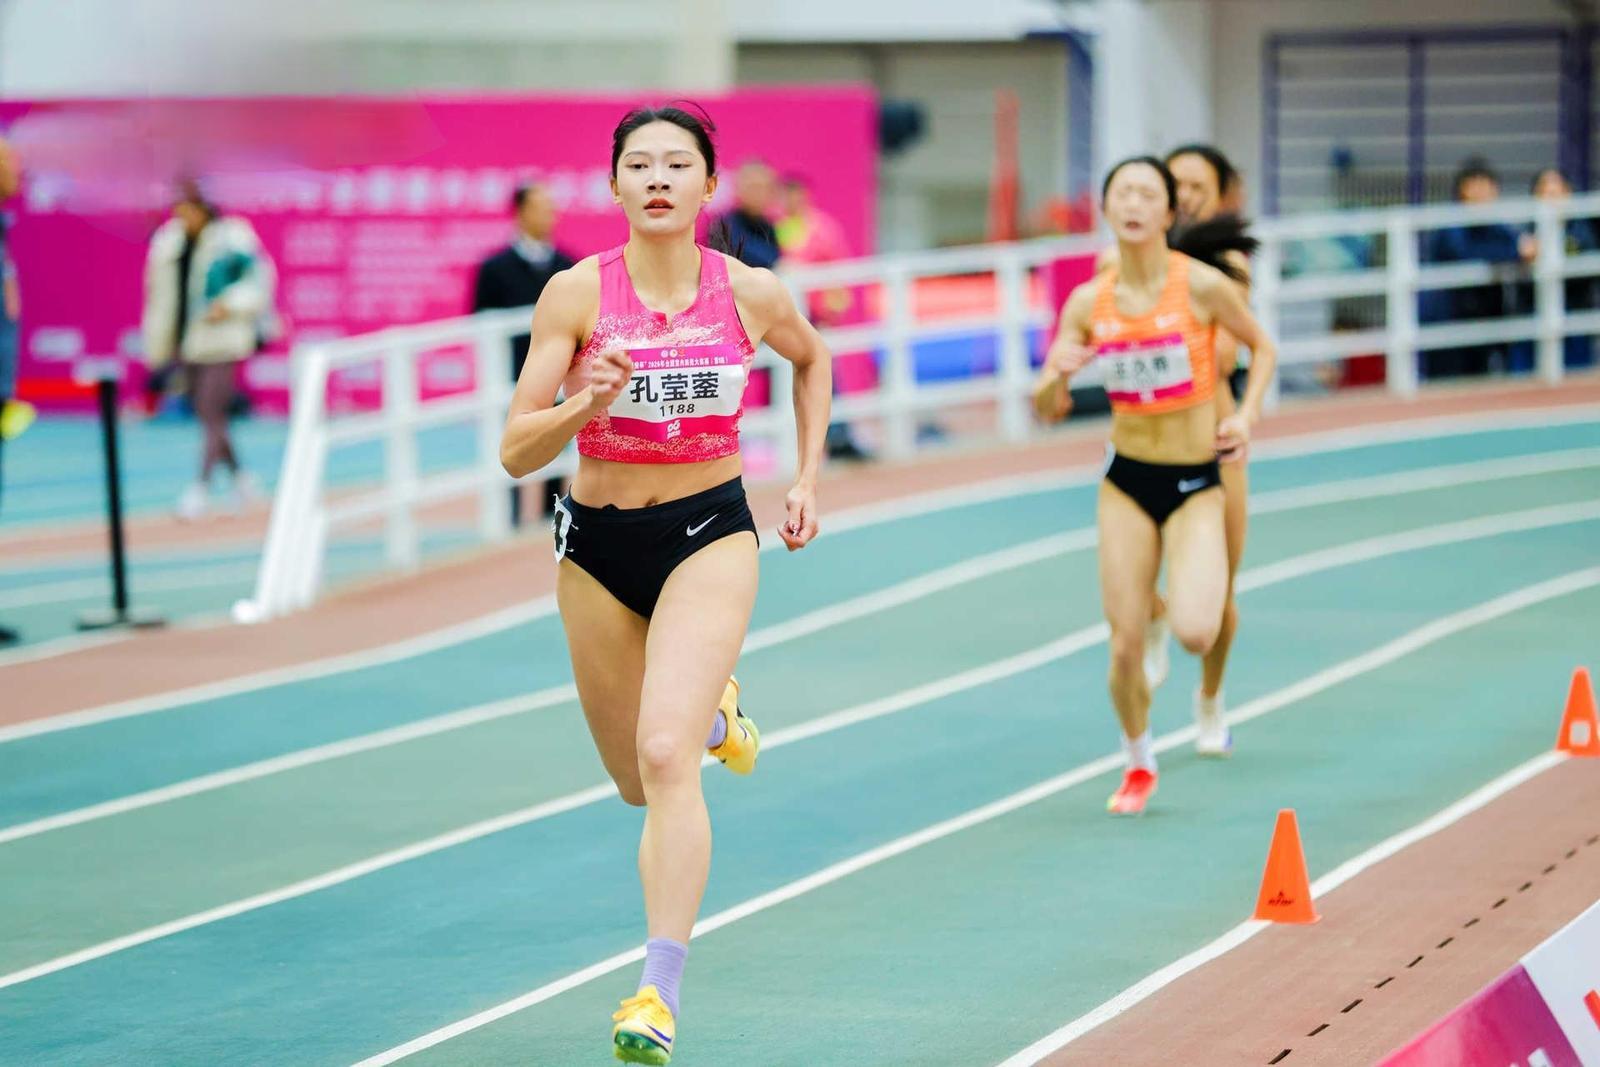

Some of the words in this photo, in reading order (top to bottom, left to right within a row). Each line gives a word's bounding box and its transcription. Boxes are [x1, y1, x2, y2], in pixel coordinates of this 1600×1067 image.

[630, 371, 719, 403] 孔莹蓥
[659, 403, 695, 418] 1188
